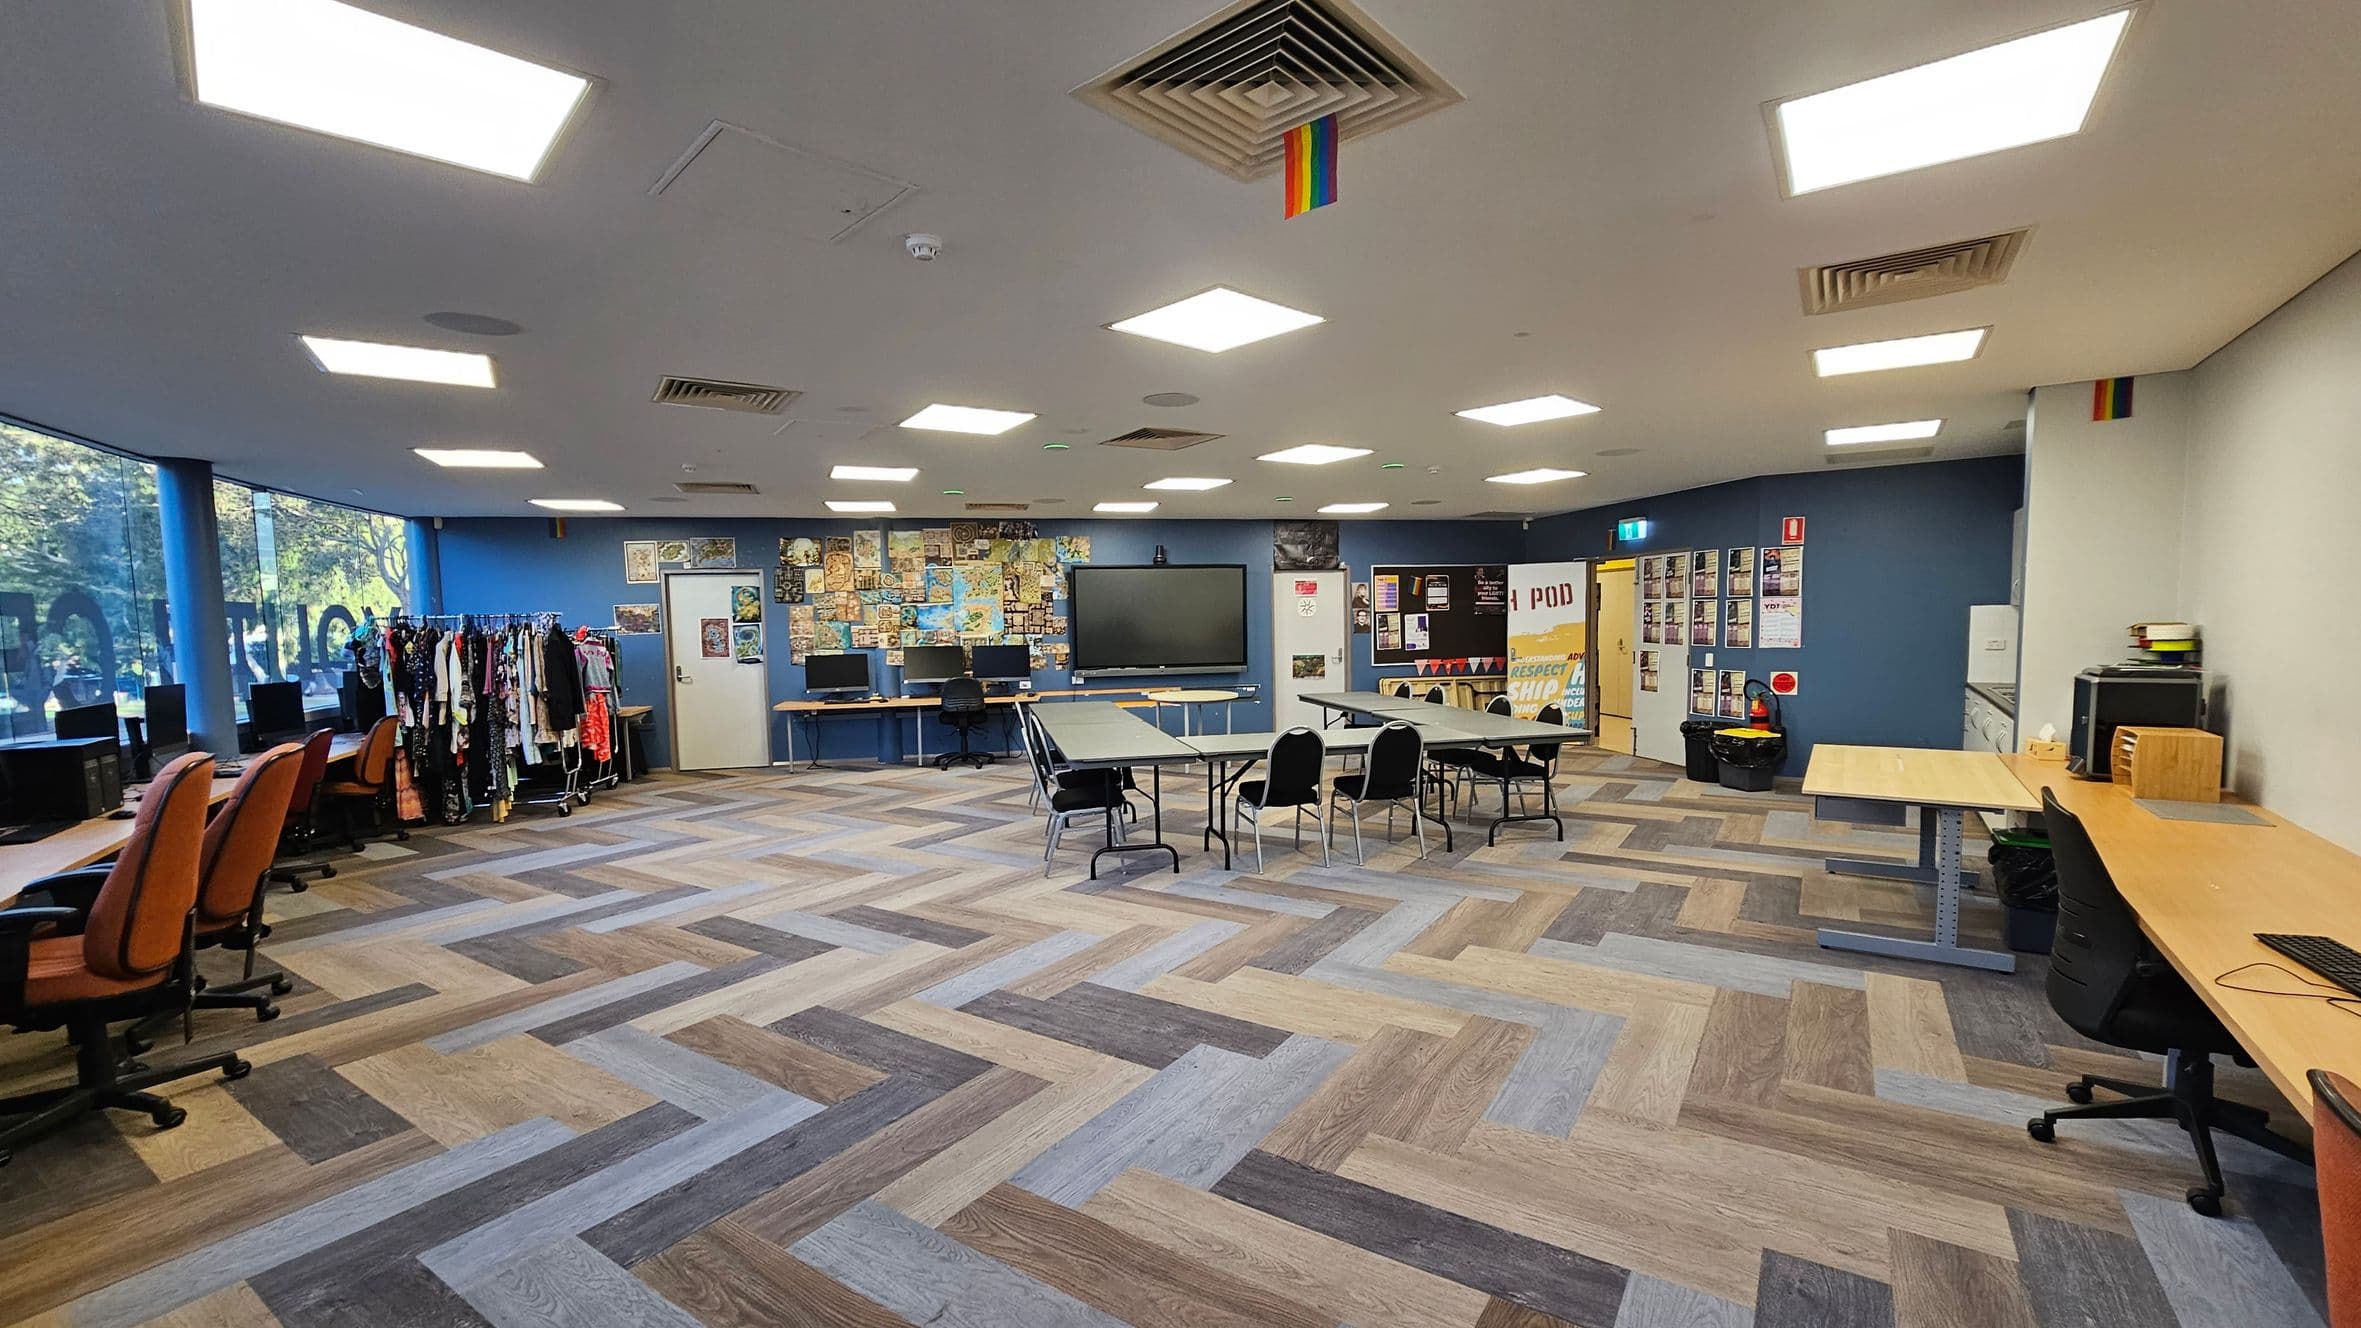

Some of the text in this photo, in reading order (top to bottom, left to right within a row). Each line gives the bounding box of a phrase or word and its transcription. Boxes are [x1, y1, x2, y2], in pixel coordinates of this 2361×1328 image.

[1531, 583, 1573, 610] POD
[1510, 662, 1568, 678] RESPECT
[1507, 679, 1559, 702] SHIP
